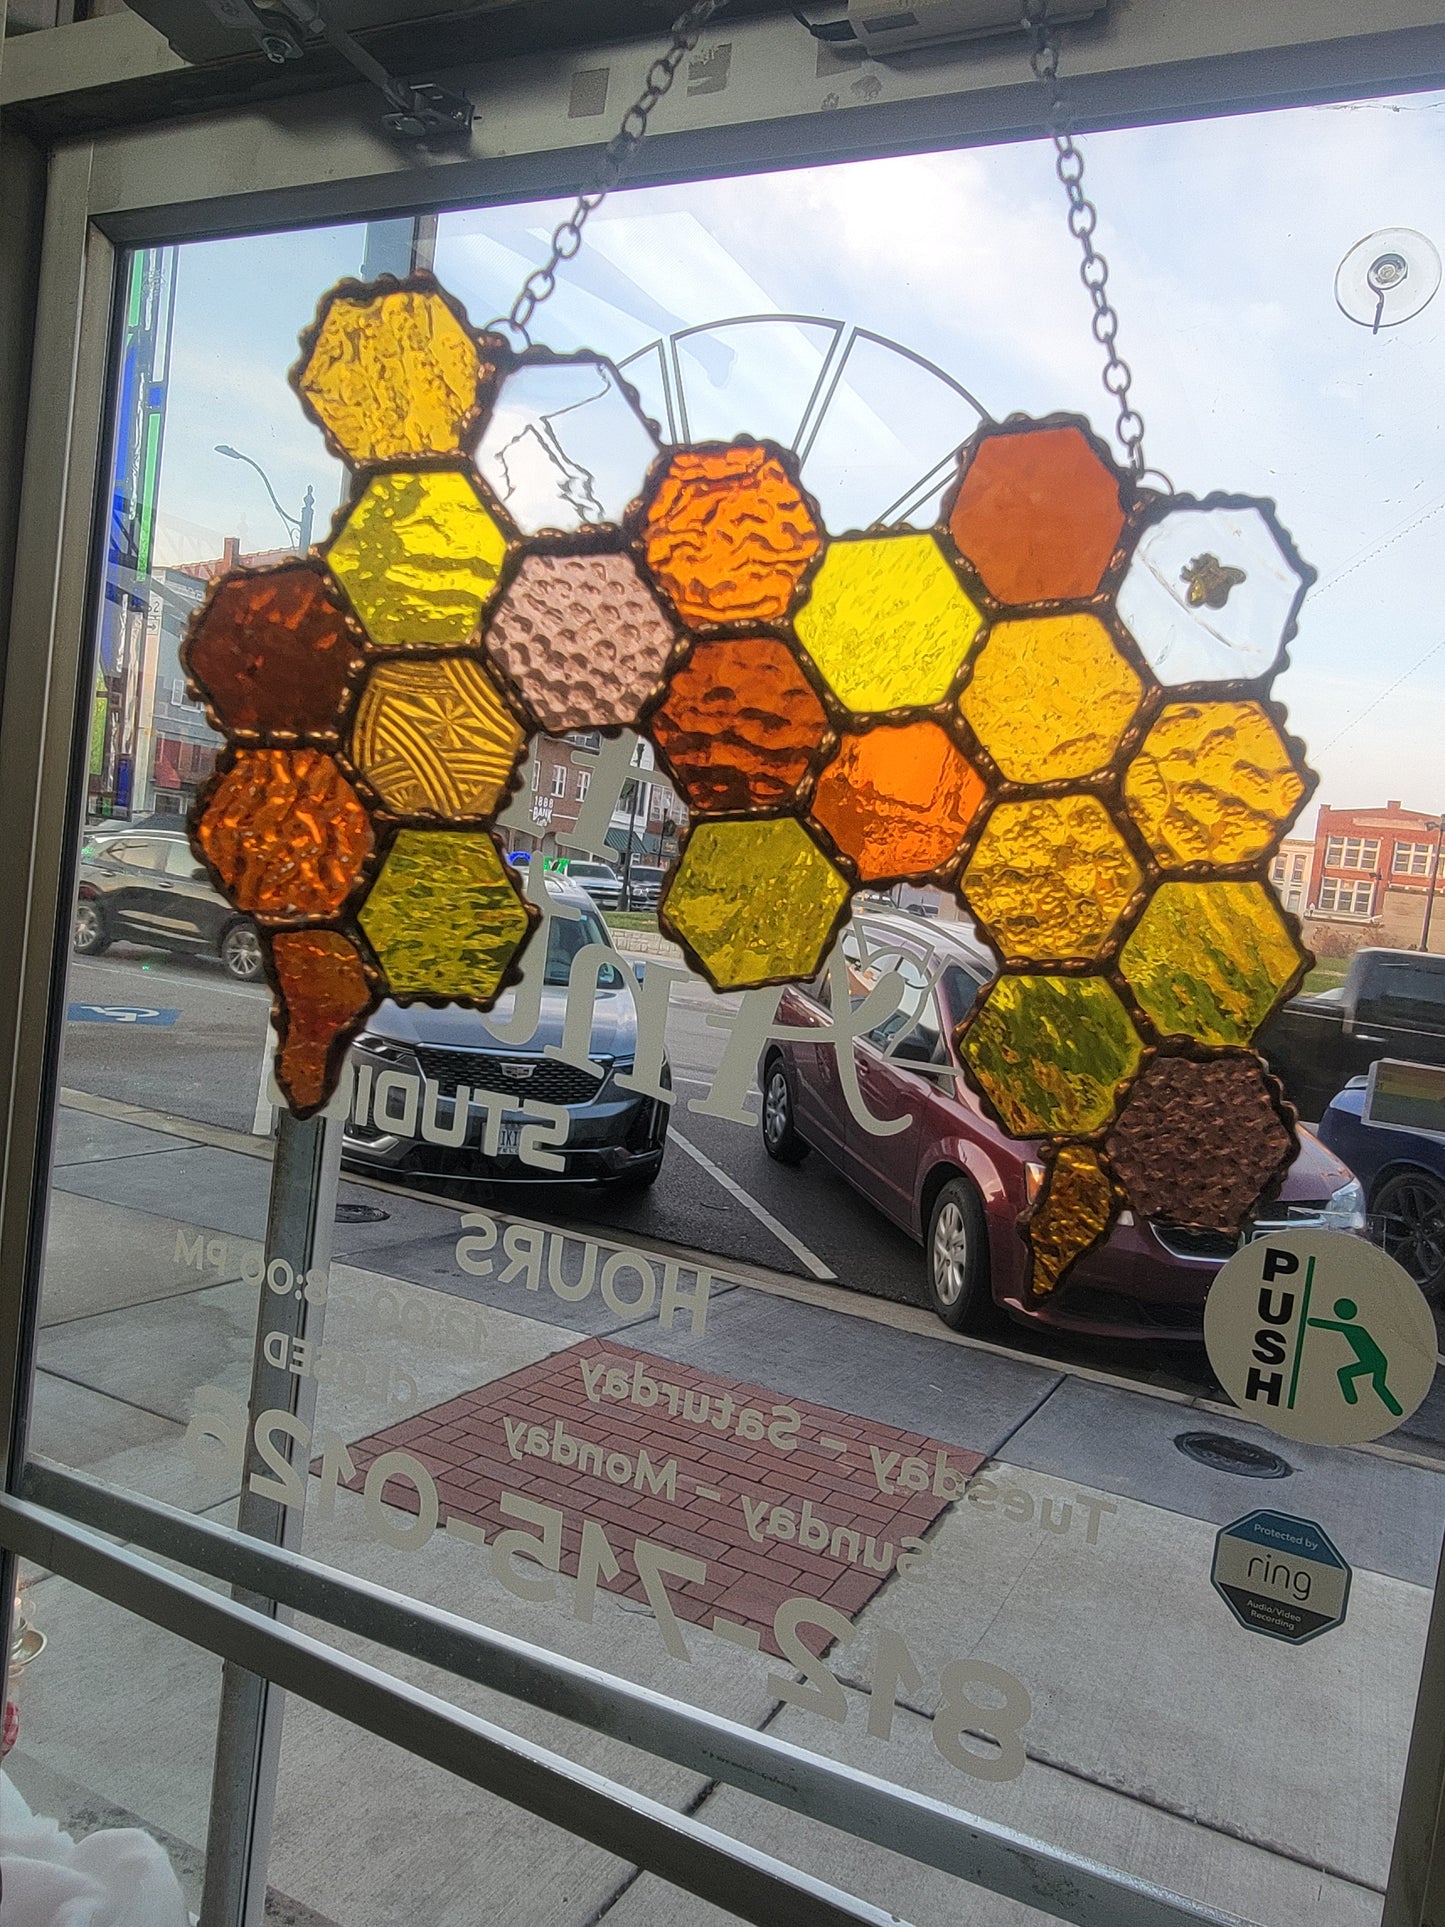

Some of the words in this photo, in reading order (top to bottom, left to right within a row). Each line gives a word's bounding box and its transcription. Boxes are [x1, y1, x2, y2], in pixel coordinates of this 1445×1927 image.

[534, 795, 554, 809] 1888
[532, 806, 553, 824] BANK
[1245, 1248, 1299, 1407] PUSH
[1254, 1523, 1303, 1546] Protected
[1305, 1536, 1319, 1551] by
[1247, 1553, 1312, 1601] ring
[1247, 1600, 1302, 1623] Audio/Video
[1250, 1609, 1295, 1631] Recording
